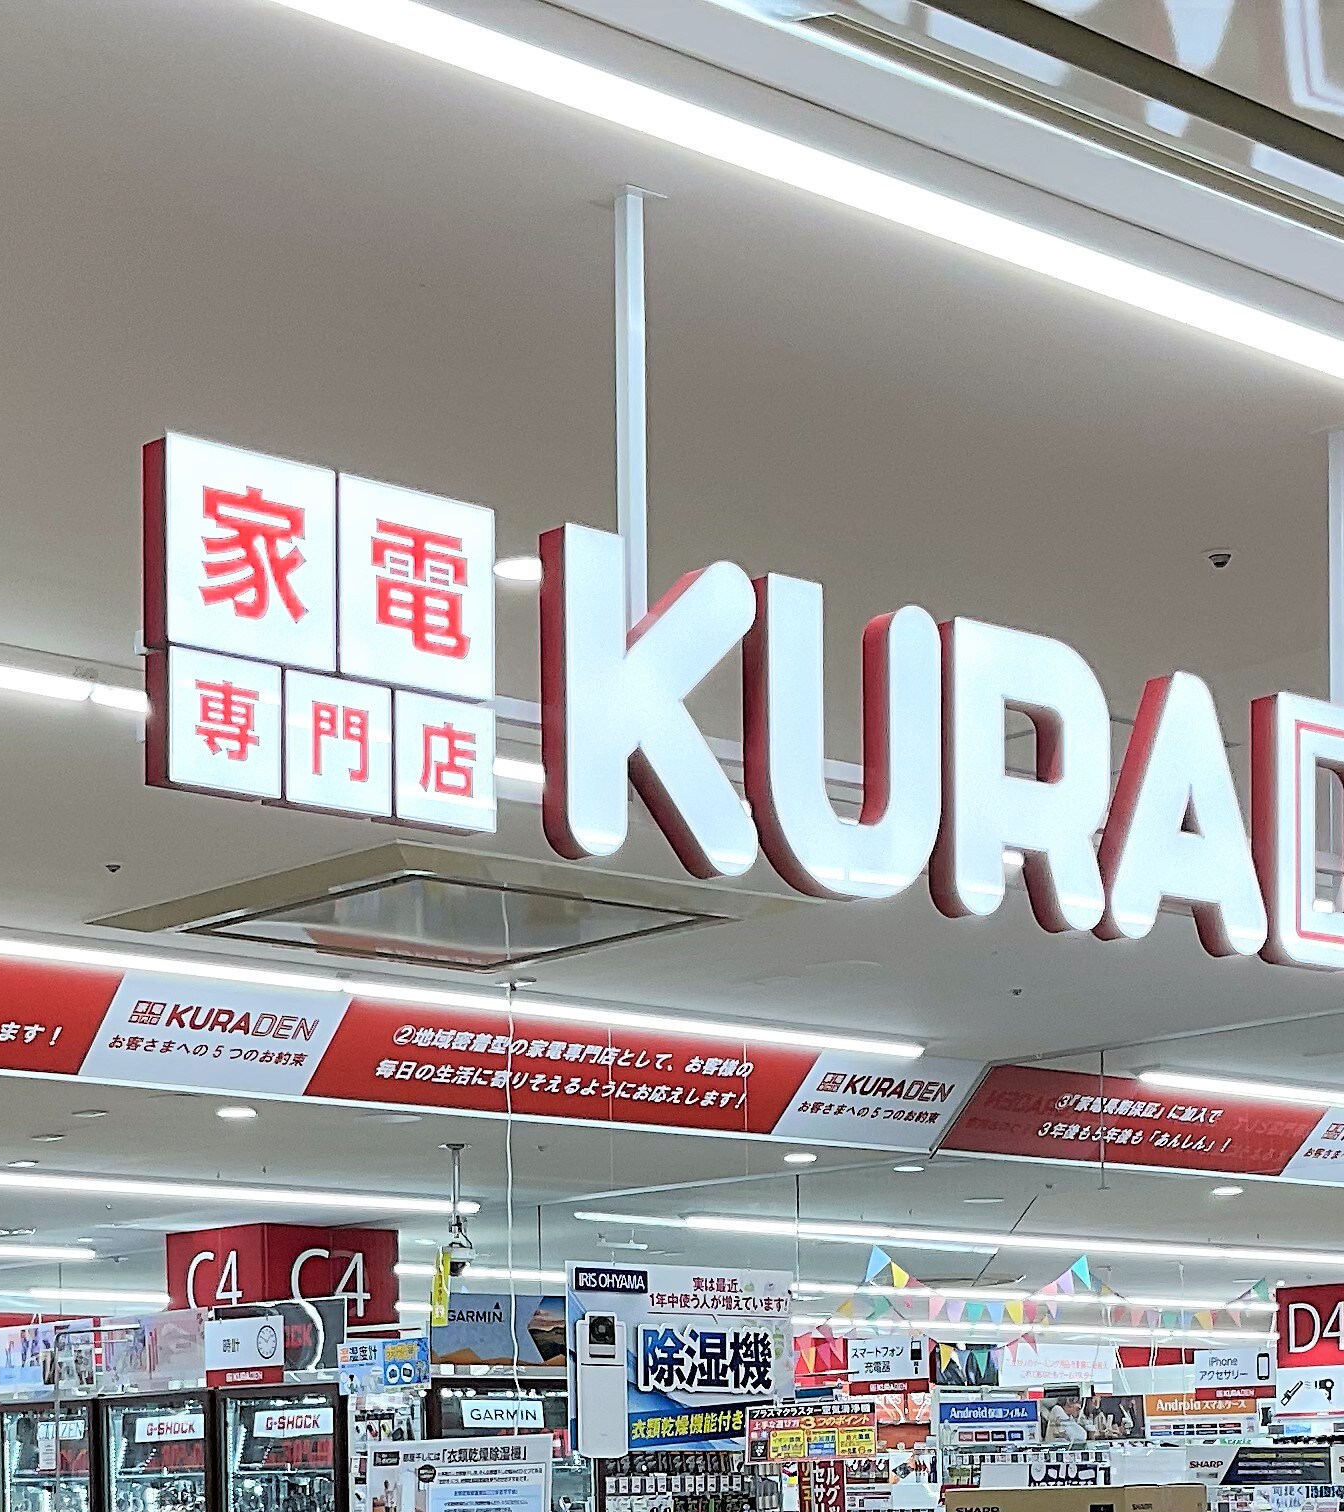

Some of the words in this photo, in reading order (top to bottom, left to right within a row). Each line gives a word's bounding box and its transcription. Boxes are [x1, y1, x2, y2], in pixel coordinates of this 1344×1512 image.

[197, 485, 470, 658] 家電
[193, 677, 479, 800] 専門店
[166, 1003, 320, 1041] KURADEN
[843, 1073, 956, 1102] KURADEN
[187, 1250, 243, 1311] C4
[291, 1249, 371, 1317] C4
[578, 1272, 597, 1288] IRIS
[599, 1274, 645, 1290] OHYAMA
[641, 1328, 773, 1392] 除湿機
[851, 1346, 904, 1359] スマートフォン
[1209, 1356, 1238, 1367] iPhone
[1199, 1370, 1249, 1380] アクセサリー
[265, 1413, 321, 1430] G-SHOCK
[470, 1407, 538, 1422] GARMIN
